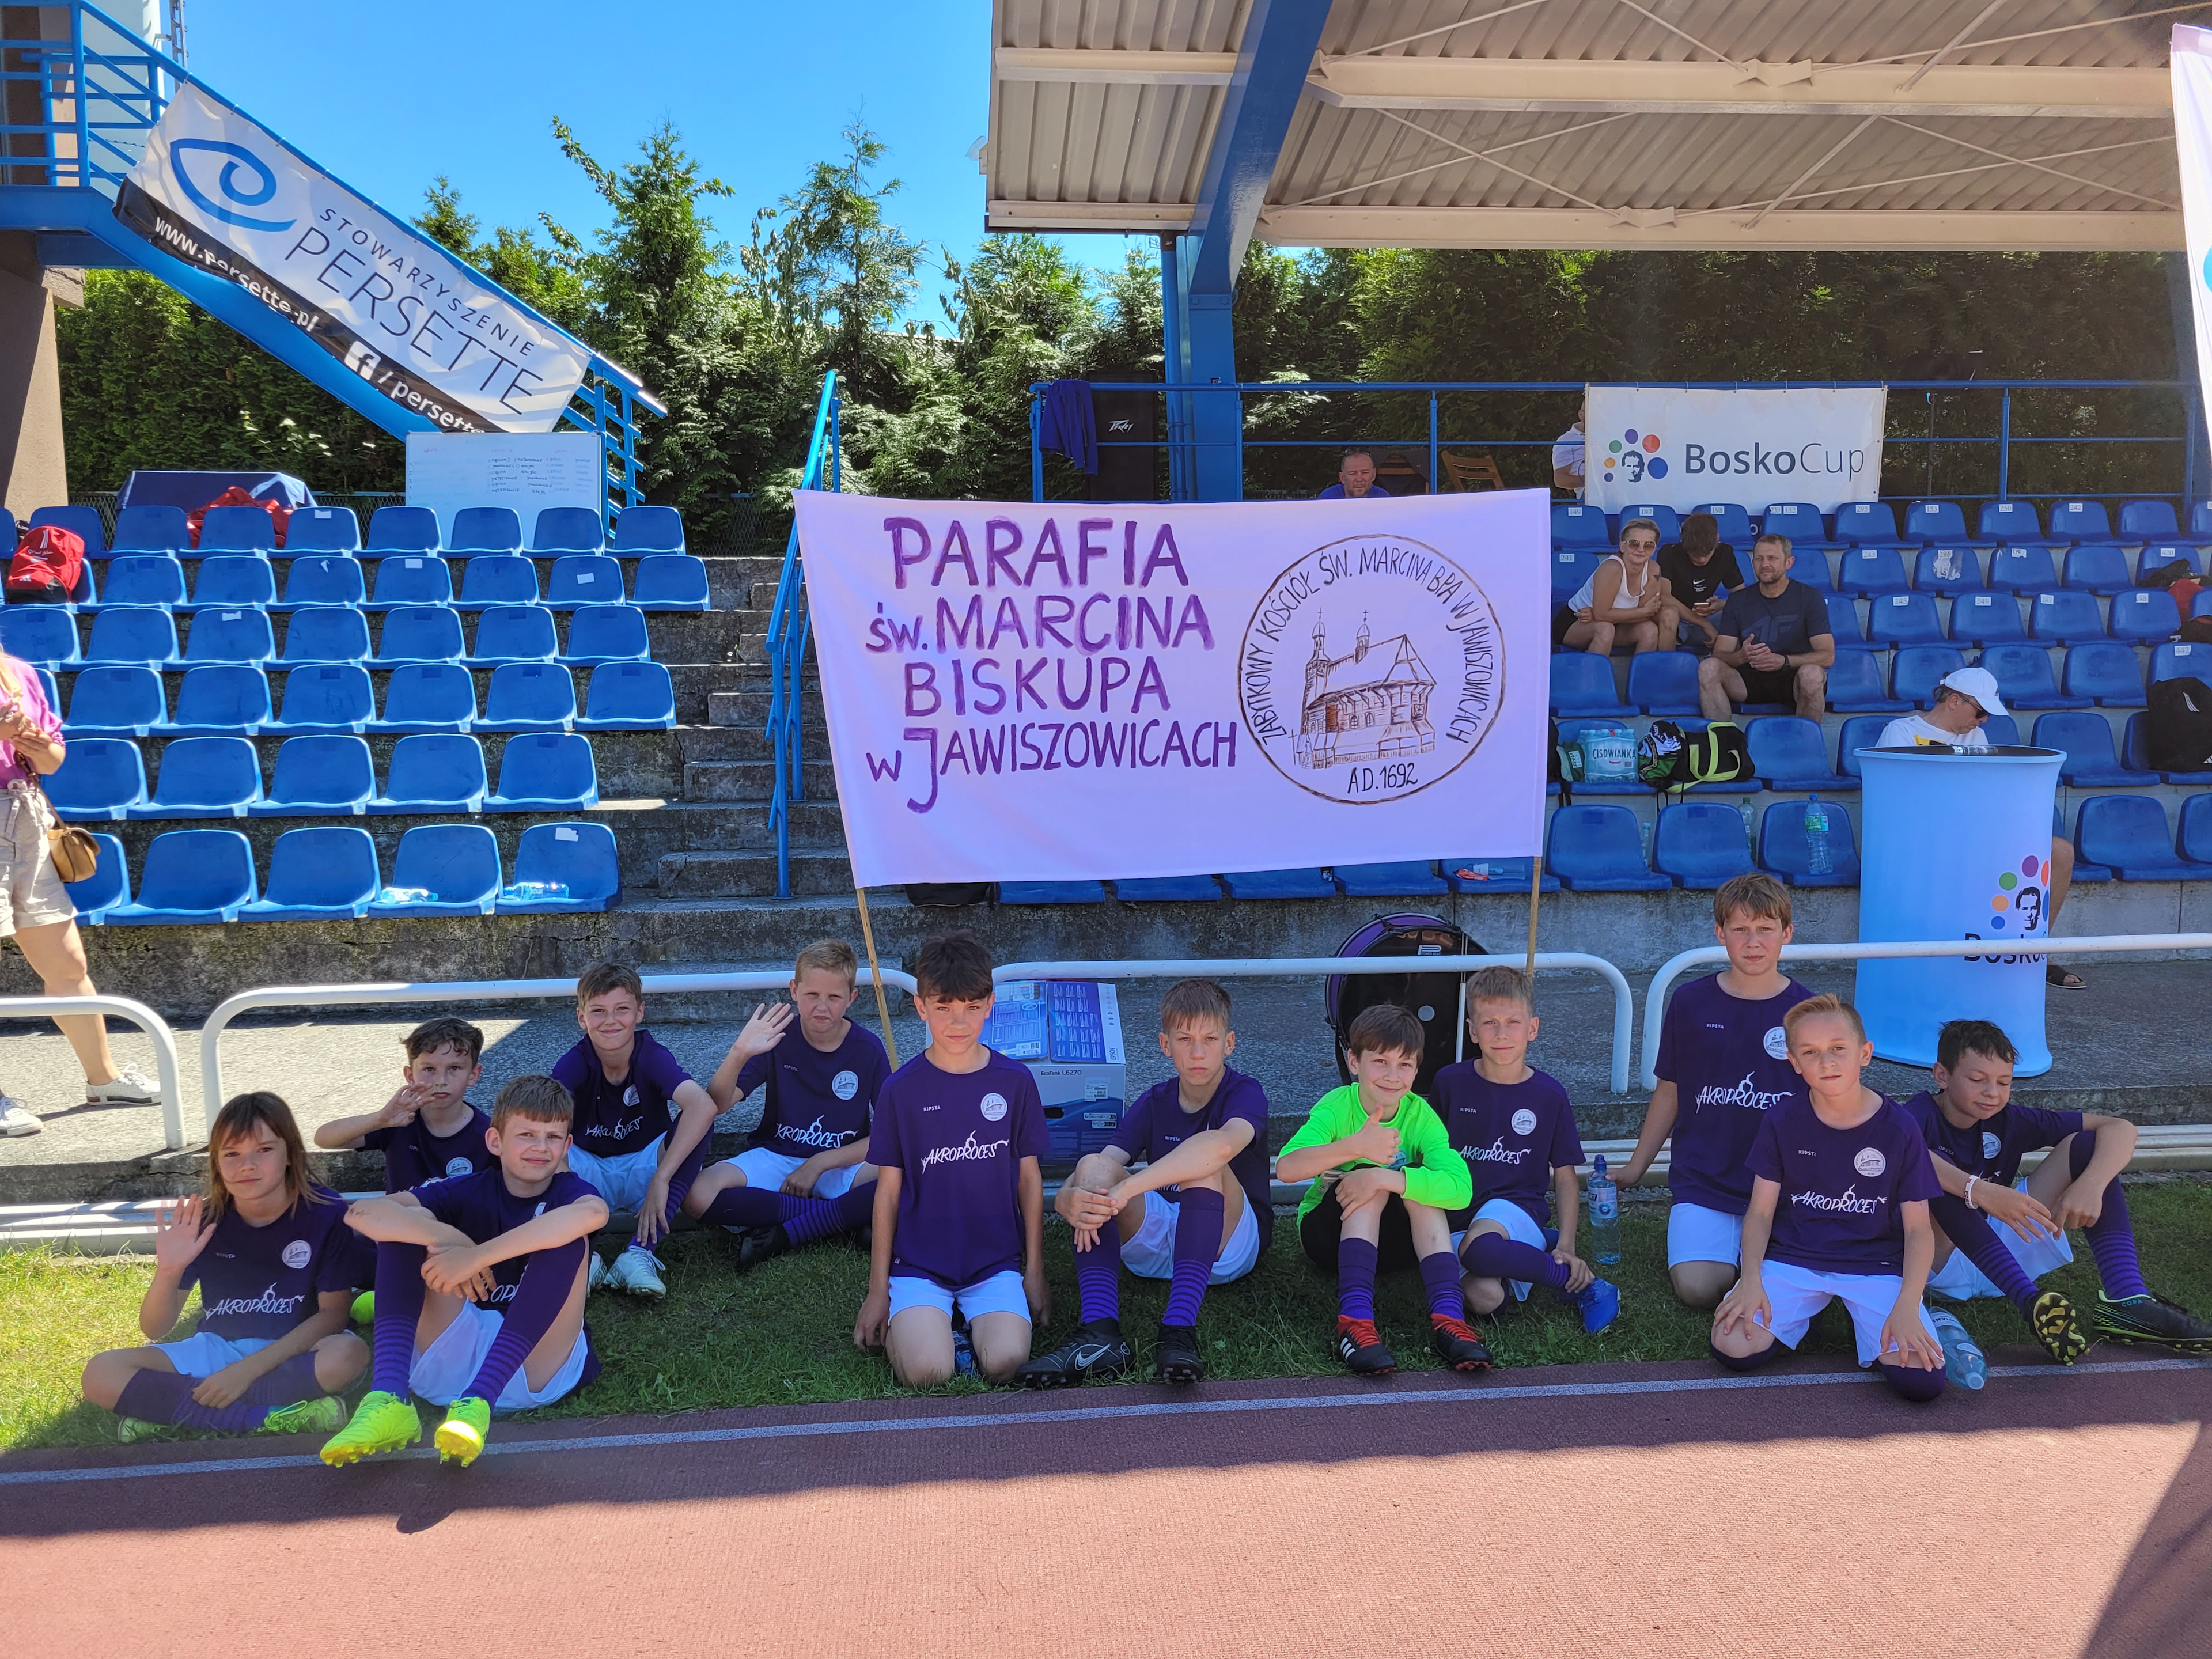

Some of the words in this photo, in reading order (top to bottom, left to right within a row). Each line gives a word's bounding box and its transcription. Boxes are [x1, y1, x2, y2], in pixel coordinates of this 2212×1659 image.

[319, 207, 535, 358] STOWARZYSZENIE
[284, 226, 544, 416] PERSETTE
[1685, 442, 1865, 482] BoskoCup
[883, 516, 1189, 590] PARAFIA
[1318, 549, 1353, 586] ŚW.
[1359, 546, 1433, 585] MARCINA
[1426, 565, 1464, 605] BPA
[935, 592, 1215, 656] MARCINA
[1255, 570, 1321, 642] KOŚCIÓŁ
[1450, 592, 1480, 620] W
[904, 656, 1171, 717] BISKUPA
[1244, 642, 1287, 745] ZABYTKOWY
[1445, 616, 1494, 744] JAWISZOWICACH
[903, 719, 1237, 814] JAWISZOWICACH
[1592, 748, 1637, 760] CISOWIANKA
[924, 1144, 998, 1165] AKROPROCES
[1459, 1145, 1523, 1165] AKROPROCES
[212, 1298, 295, 1316] AKROPROCES
[2121, 1298, 2143, 1308] COPA
